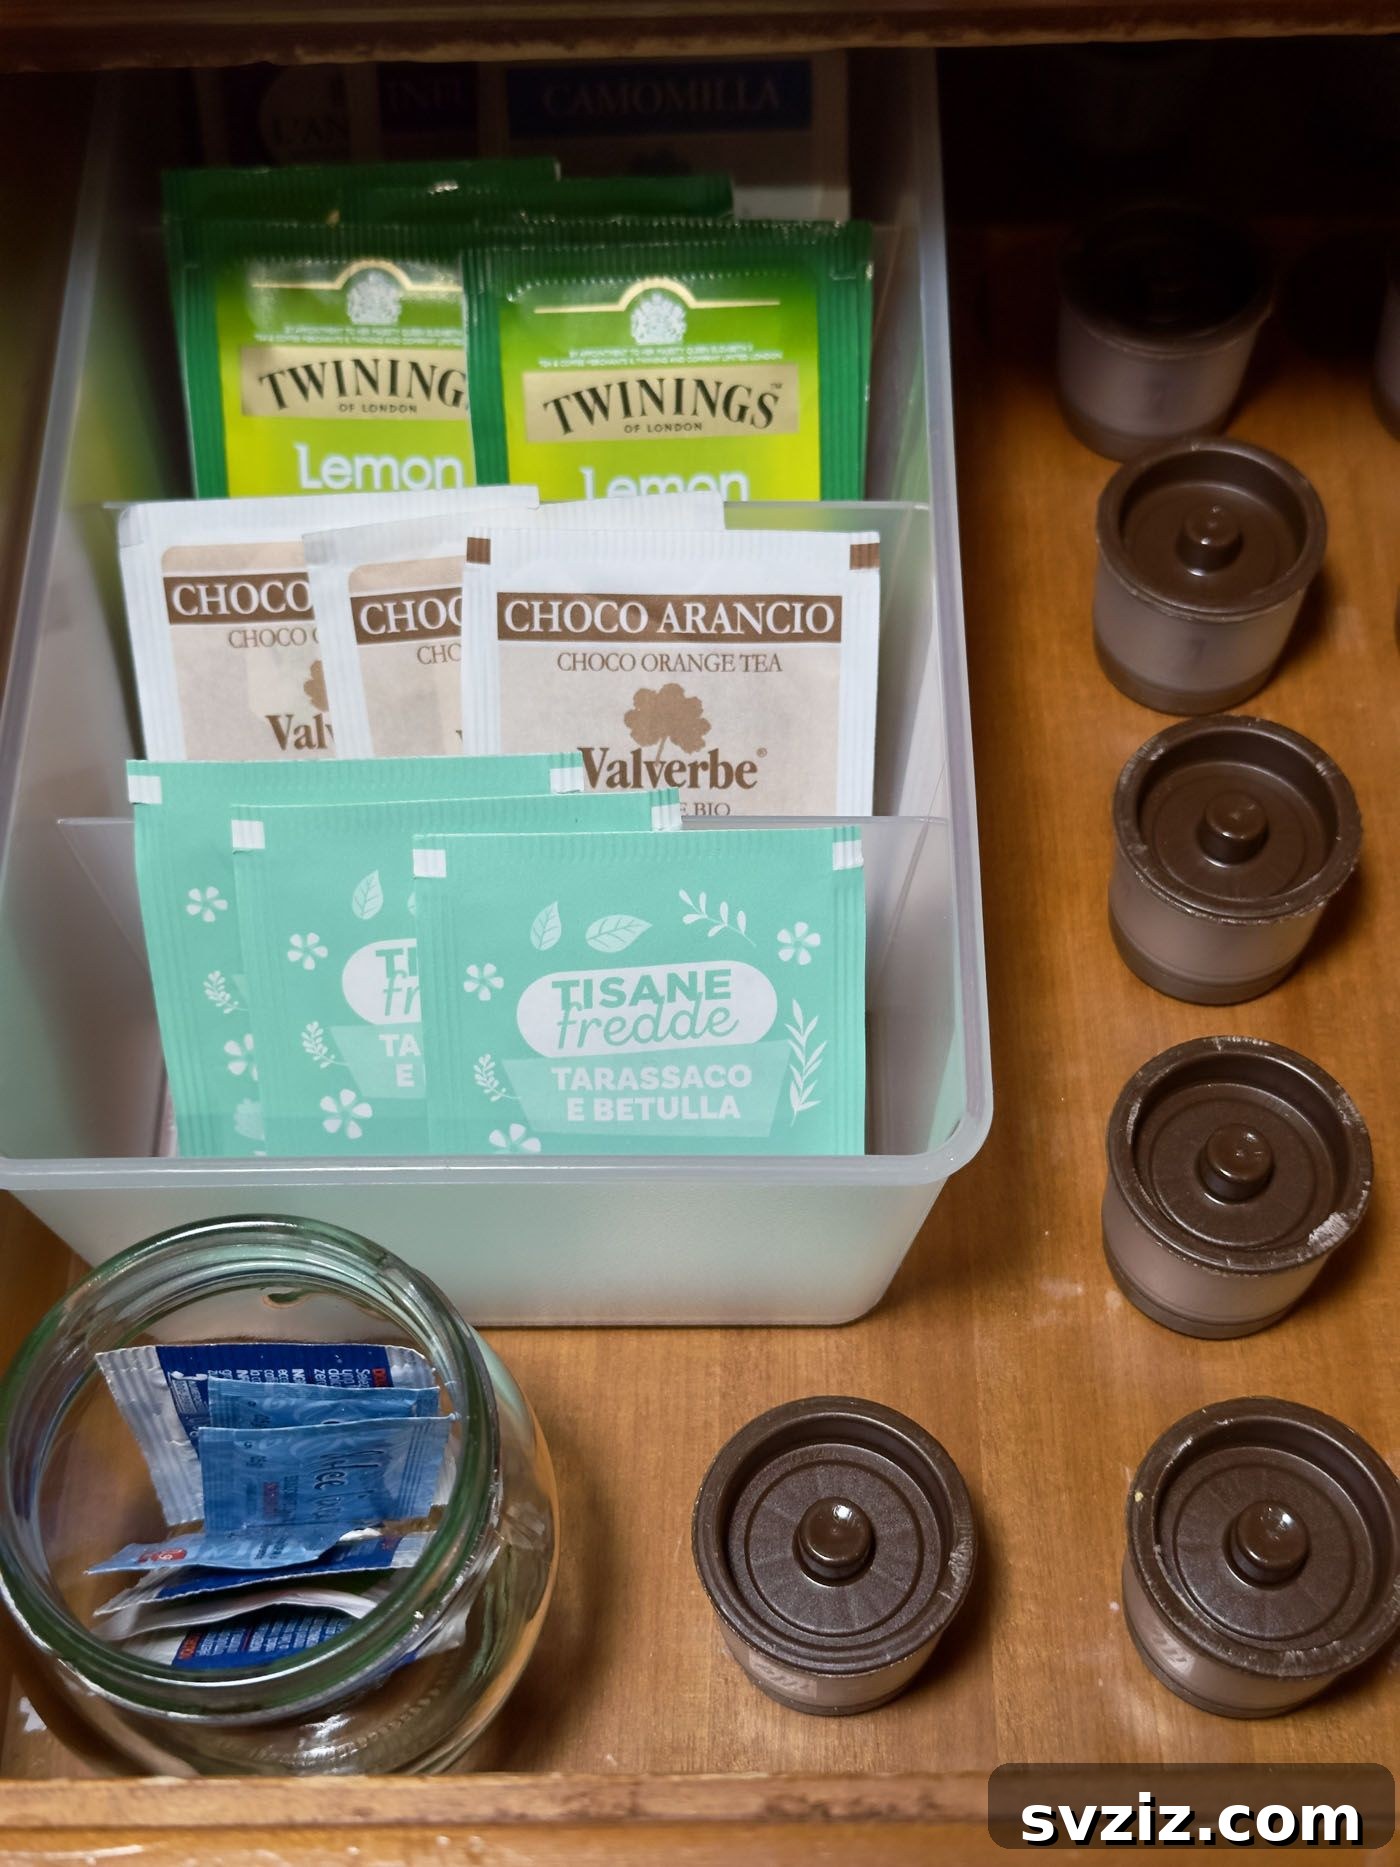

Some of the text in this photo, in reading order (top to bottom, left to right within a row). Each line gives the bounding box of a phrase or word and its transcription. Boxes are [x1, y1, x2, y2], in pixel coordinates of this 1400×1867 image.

[541, 76, 782, 117] CAMOMILLA
[258, 357, 467, 410] TWINING
[338, 403, 417, 413] OF LONDON
[543, 378, 779, 435] TWININGS
[624, 422, 703, 434] OF LONDON
[293, 442, 464, 490] Lemon
[580, 465, 749, 501] Lemon
[172, 580, 313, 617] CHOCO
[504, 600, 835, 634] CHOCO ARANCIO
[228, 627, 307, 649] CHOCO
[557, 652, 783, 672] CHOCO ORANGE TEA
[694, 802, 731, 816] BIO
[551, 969, 732, 1011] TISANE
[556, 991, 739, 1049] fredde
[378, 1034, 422, 1057] TA
[395, 1063, 415, 1087] E
[551, 1064, 753, 1091] TARASSACO
[567, 1095, 741, 1121] E BETULLA
